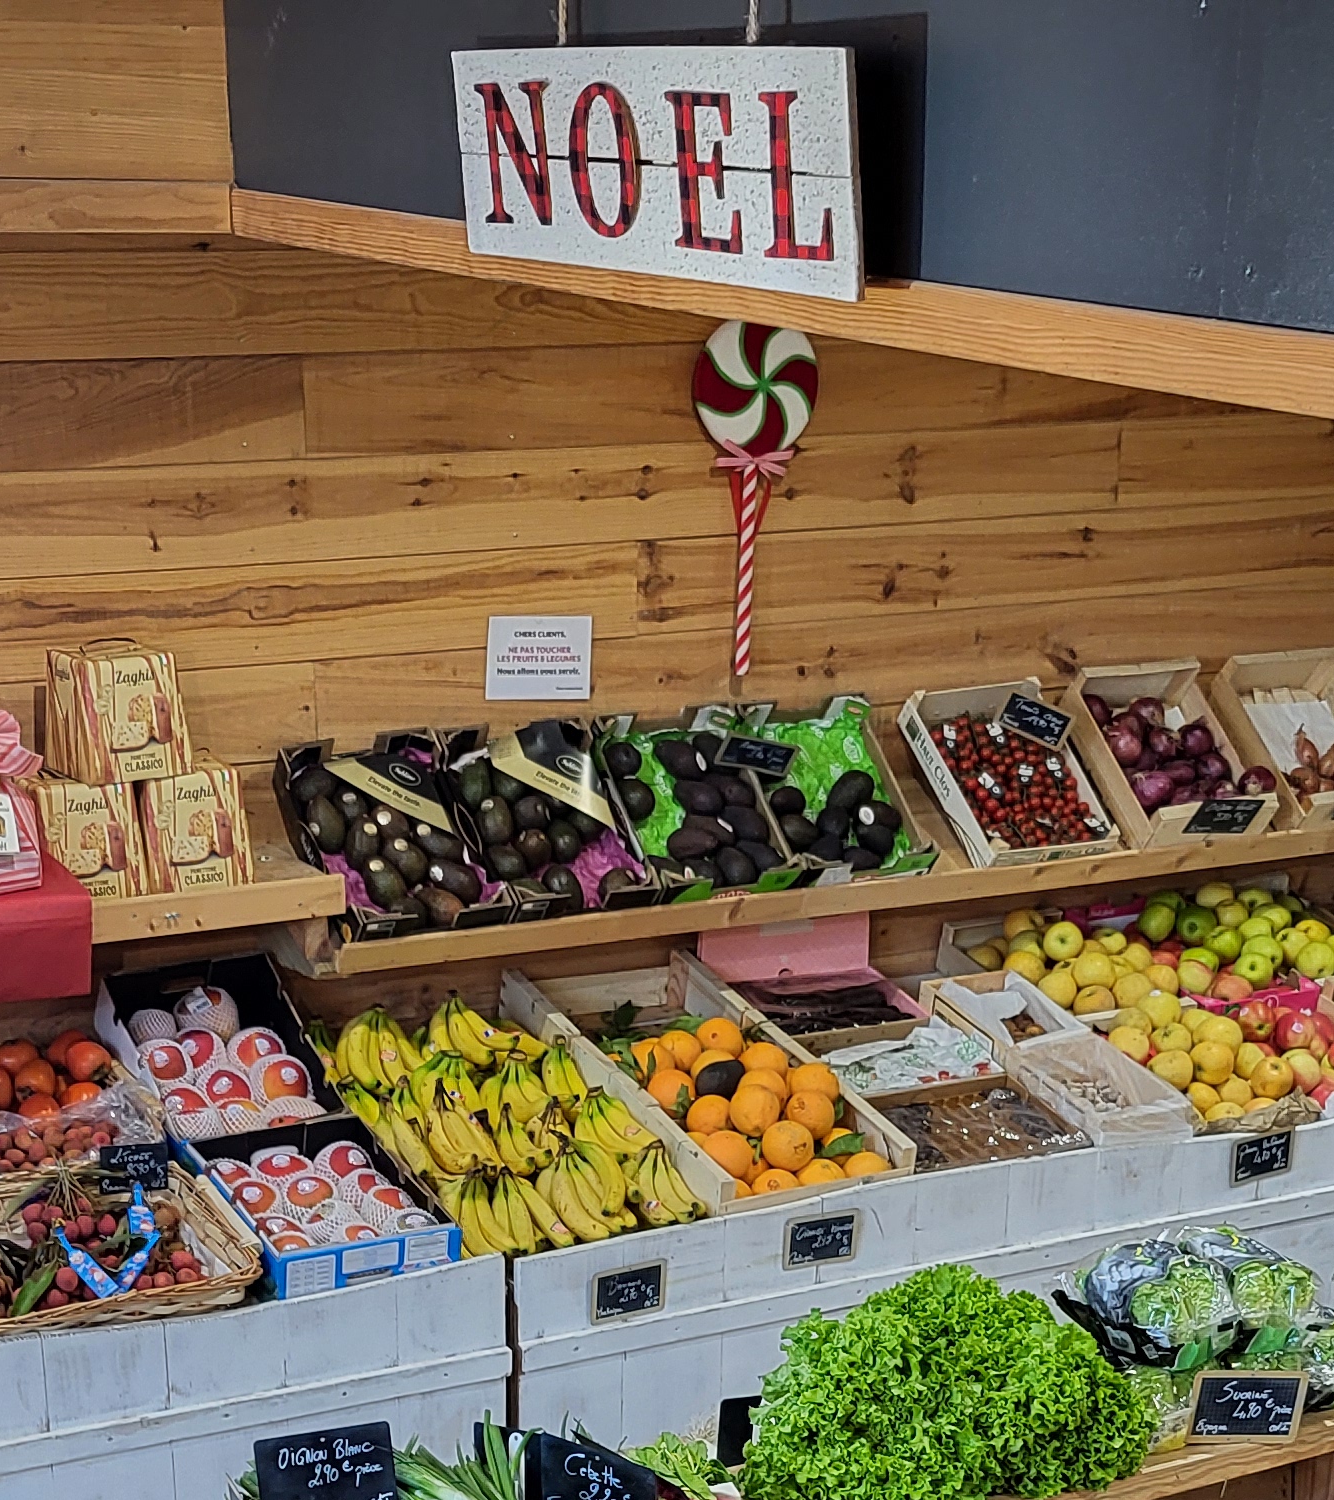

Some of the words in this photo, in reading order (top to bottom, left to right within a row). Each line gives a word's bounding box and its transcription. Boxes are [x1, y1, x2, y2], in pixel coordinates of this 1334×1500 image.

[474, 81, 835, 261] NOEL
[124, 759, 163, 773] CLASSICO
[185, 872, 224, 886] CLASSICO
[90, 886, 116, 897] ASSICO
